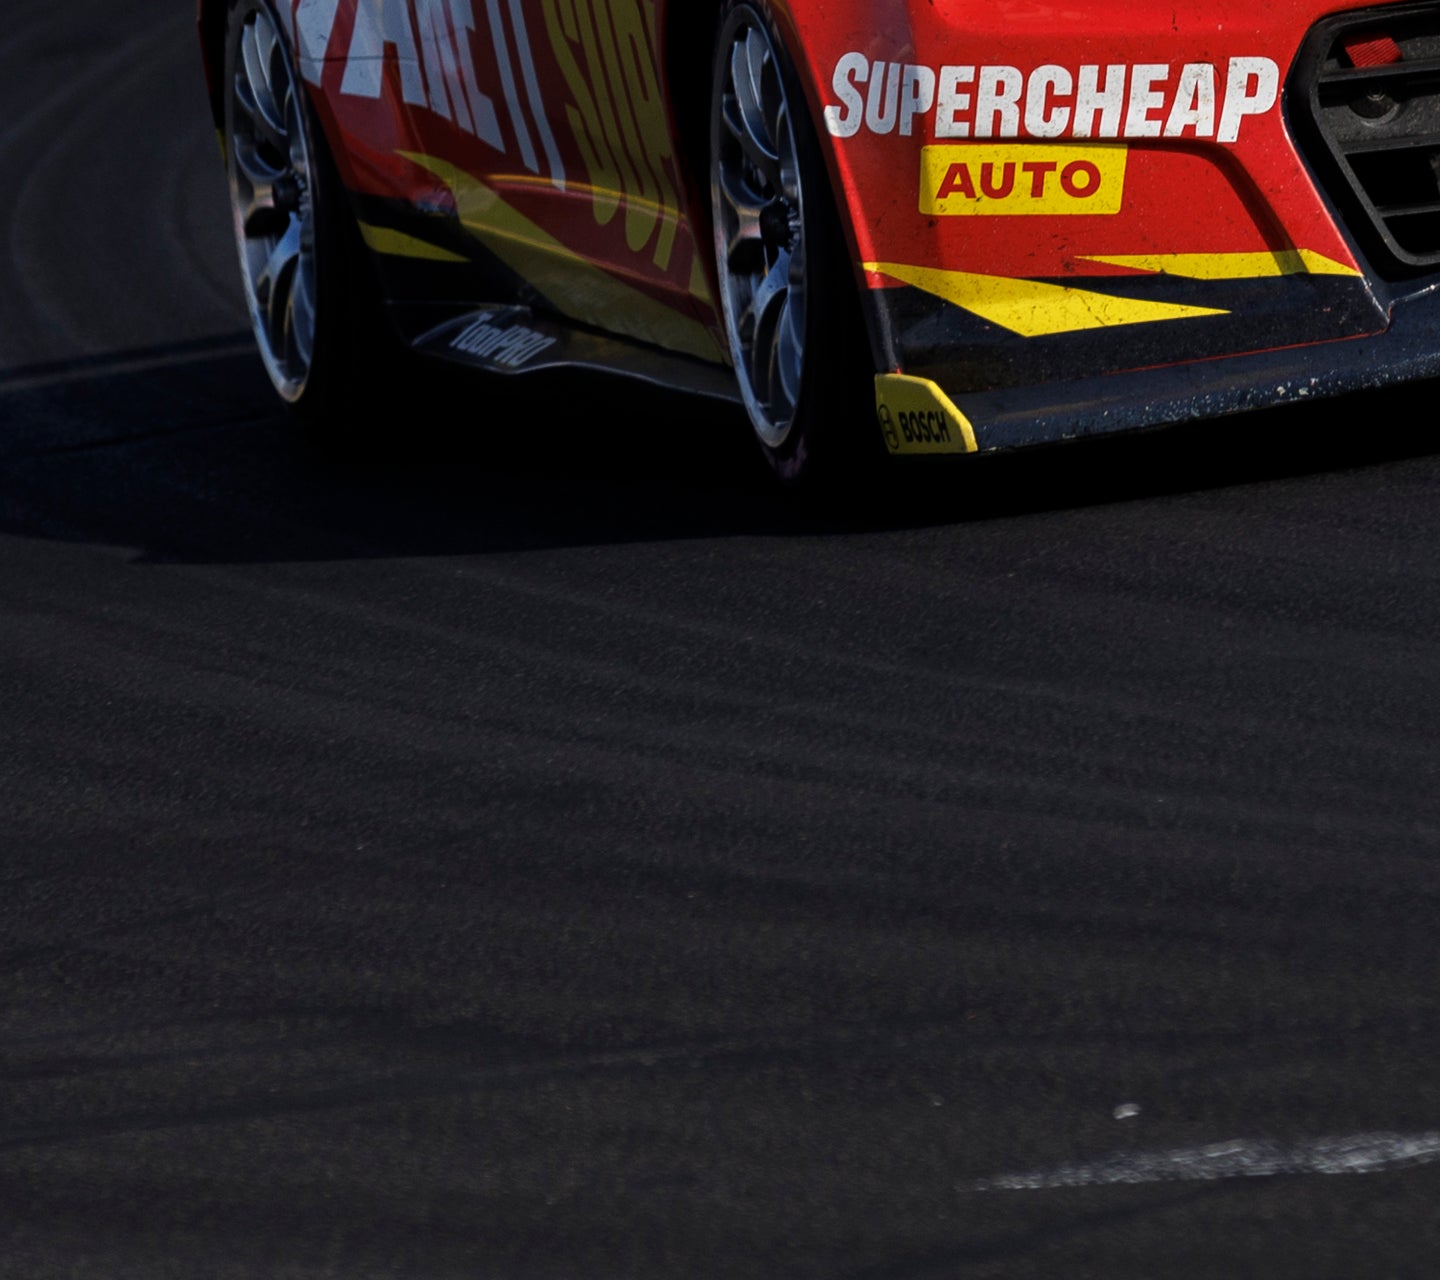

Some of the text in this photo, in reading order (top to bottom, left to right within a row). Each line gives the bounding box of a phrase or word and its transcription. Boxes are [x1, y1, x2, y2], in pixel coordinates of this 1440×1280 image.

[822, 50, 1281, 143] SUPERCHEAP
[935, 159, 1103, 200] AUTO
[897, 410, 951, 445] BOSCH
